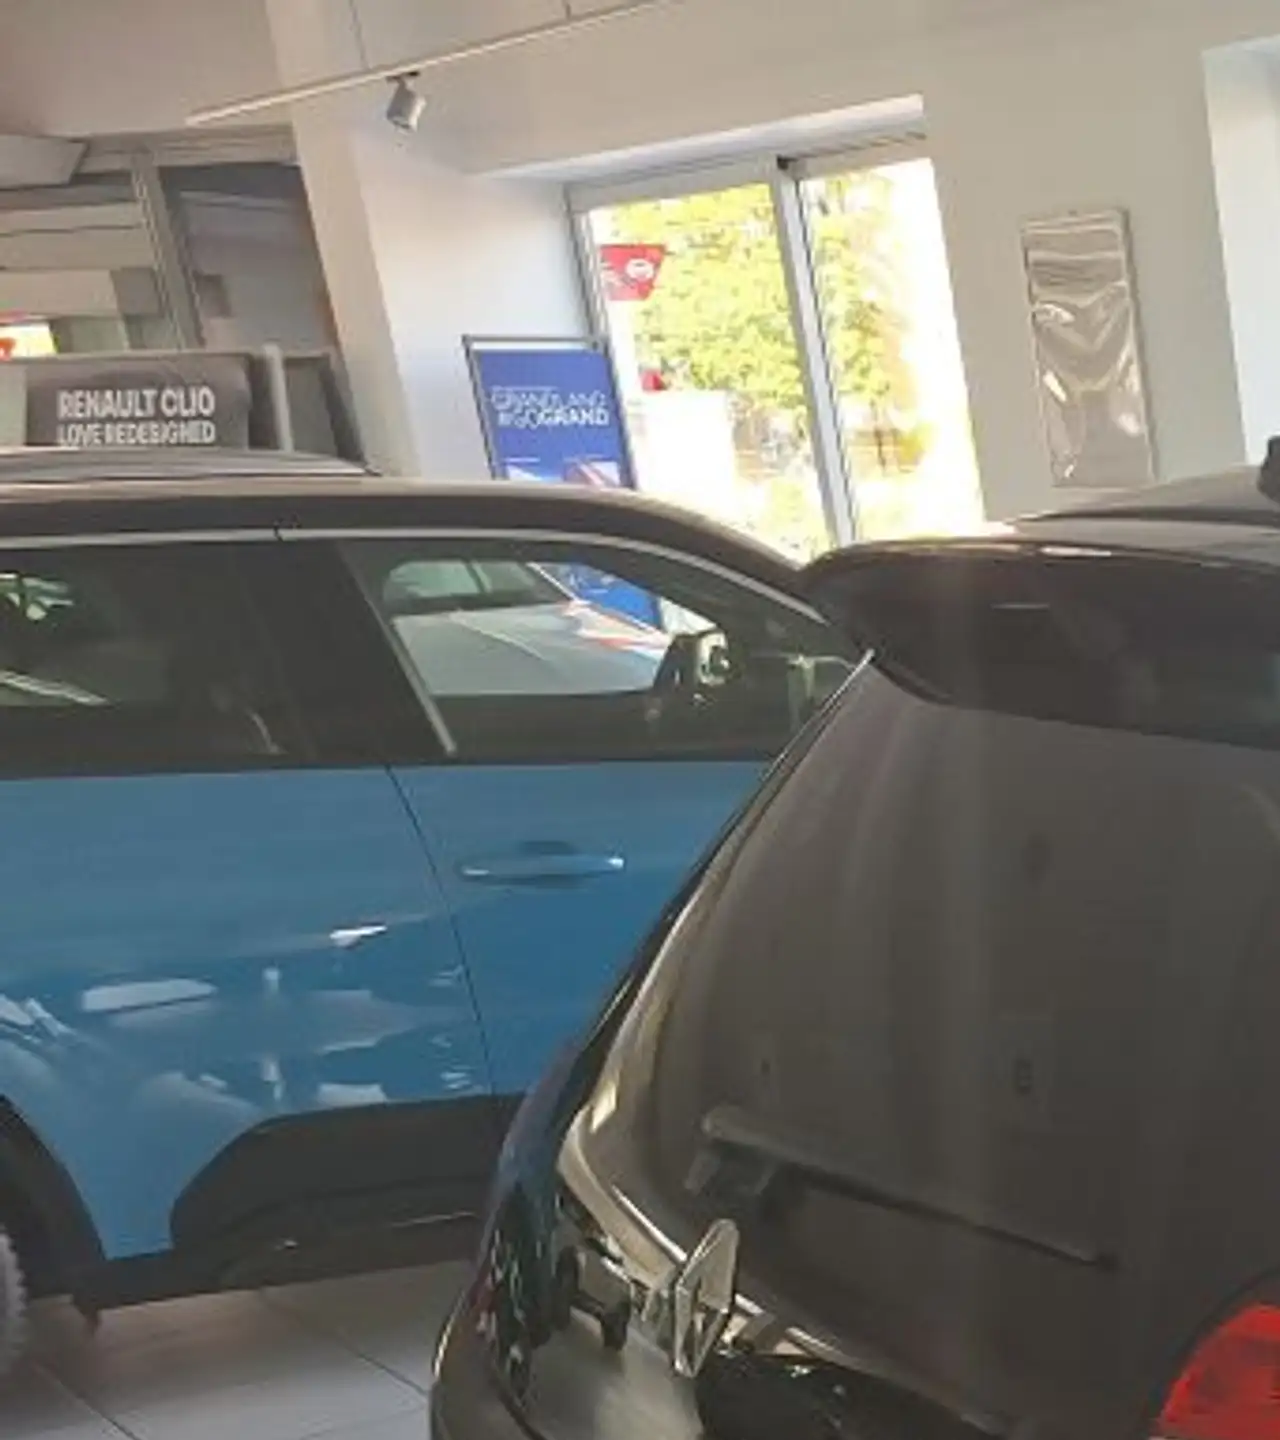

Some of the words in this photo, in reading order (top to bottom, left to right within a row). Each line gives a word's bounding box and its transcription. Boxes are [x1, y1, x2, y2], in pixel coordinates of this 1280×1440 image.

[58, 389, 157, 419] RENAULT
[160, 386, 216, 417] CLIO
[58, 422, 102, 447] LOVE
